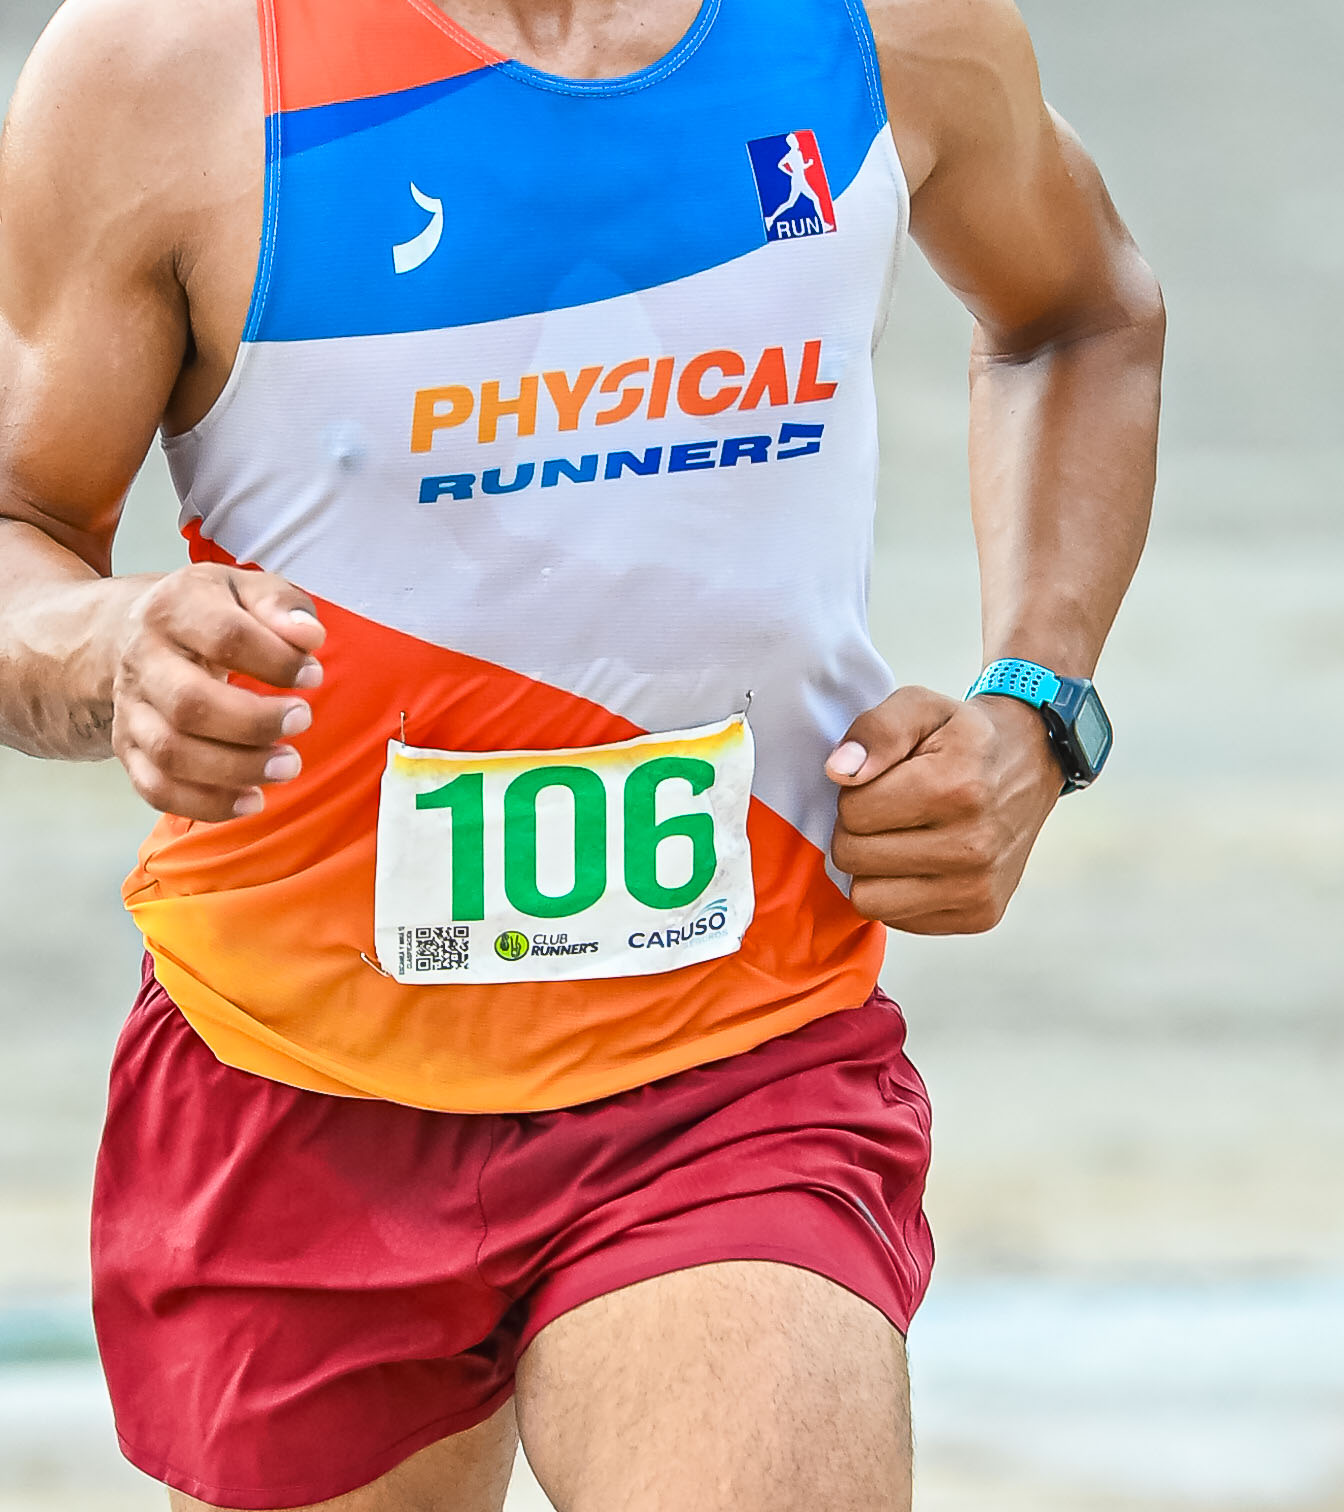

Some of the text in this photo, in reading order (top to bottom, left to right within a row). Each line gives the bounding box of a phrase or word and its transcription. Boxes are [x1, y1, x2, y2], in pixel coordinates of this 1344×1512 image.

[777, 216, 820, 238] RUN
[411, 340, 837, 453] PHYSICAL
[416, 756, 717, 921] 106
[532, 933, 568, 945] CLUB
[628, 912, 726, 948] CARUSO
[531, 941, 599, 956] RUNNER'S
